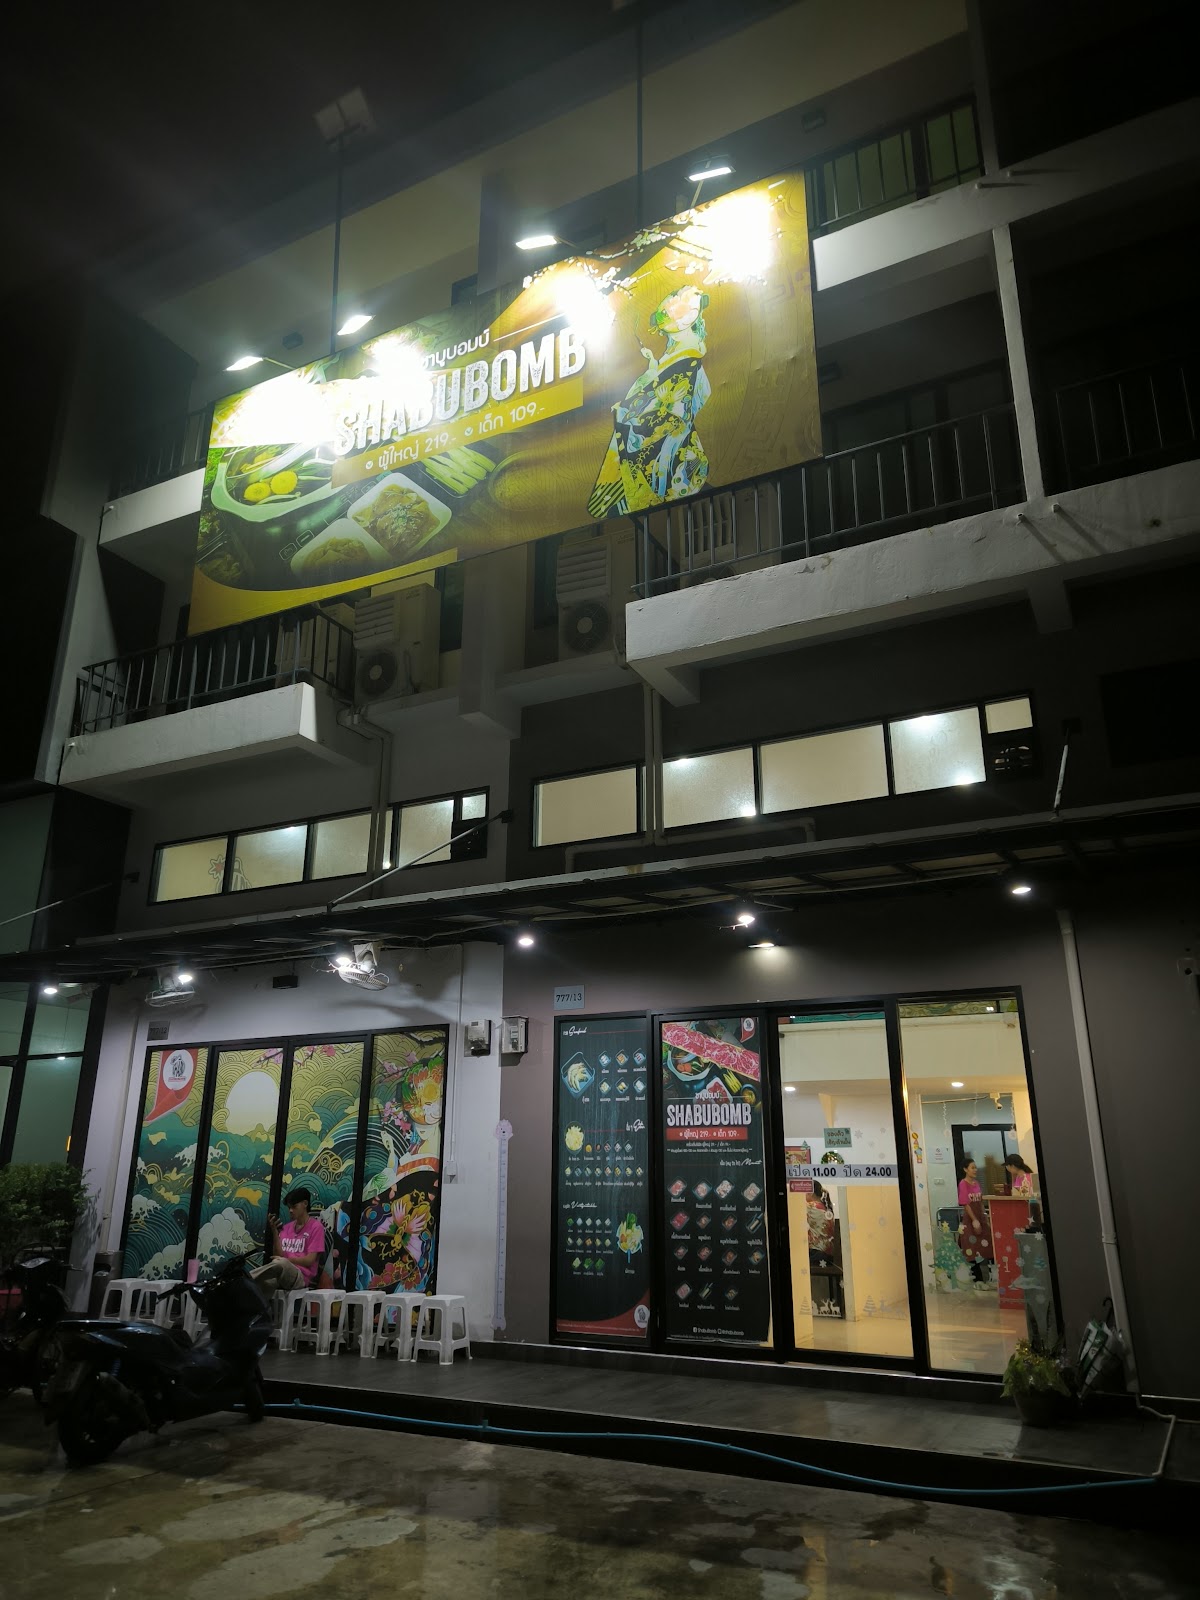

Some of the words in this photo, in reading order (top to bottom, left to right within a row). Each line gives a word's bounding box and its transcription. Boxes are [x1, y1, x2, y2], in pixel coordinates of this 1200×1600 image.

[334, 327, 586, 455] SHABUBOMB
[378, 439, 420, 471] ผู้ใหญ่
[478, 413, 504, 435] เด็ก
[555, 992, 583, 1003] 777/13
[666, 1102, 753, 1127] SHABUBOMB
[788, 1164, 811, 1177] เปิด
[812, 1167, 837, 1177] 11.00
[842, 1164, 863, 1177] ปิด
[865, 1166, 893, 1177] 24.00
